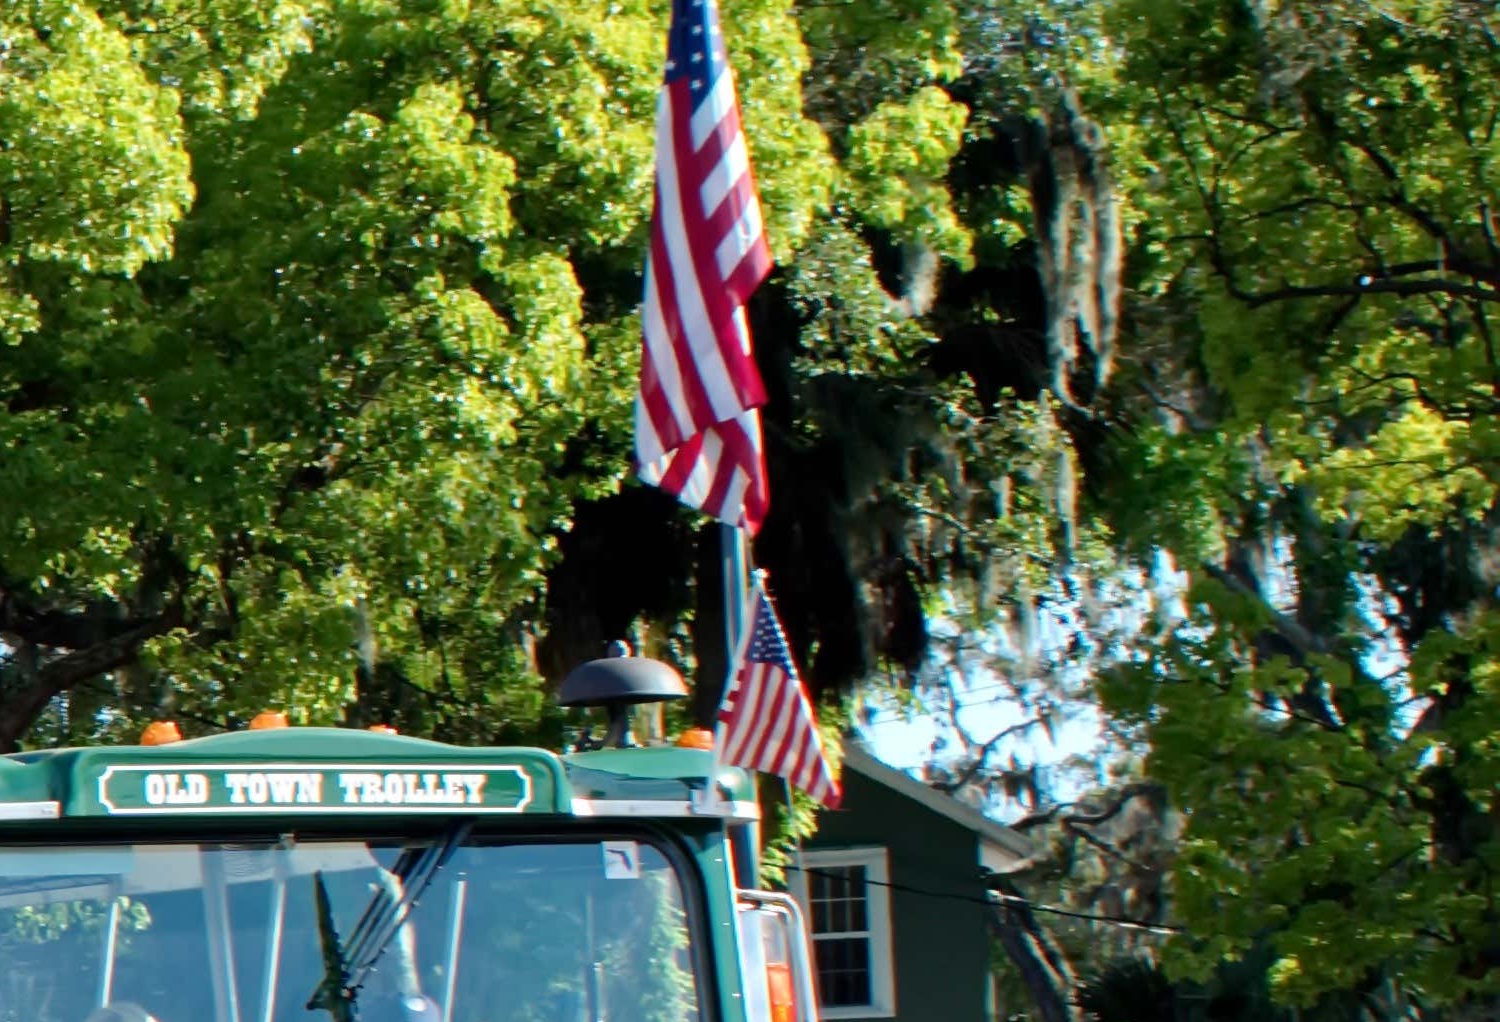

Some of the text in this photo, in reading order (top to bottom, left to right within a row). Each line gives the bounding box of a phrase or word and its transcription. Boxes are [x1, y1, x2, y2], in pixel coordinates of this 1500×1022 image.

[144, 772, 487, 804] OLD TOWN TROLLEY
